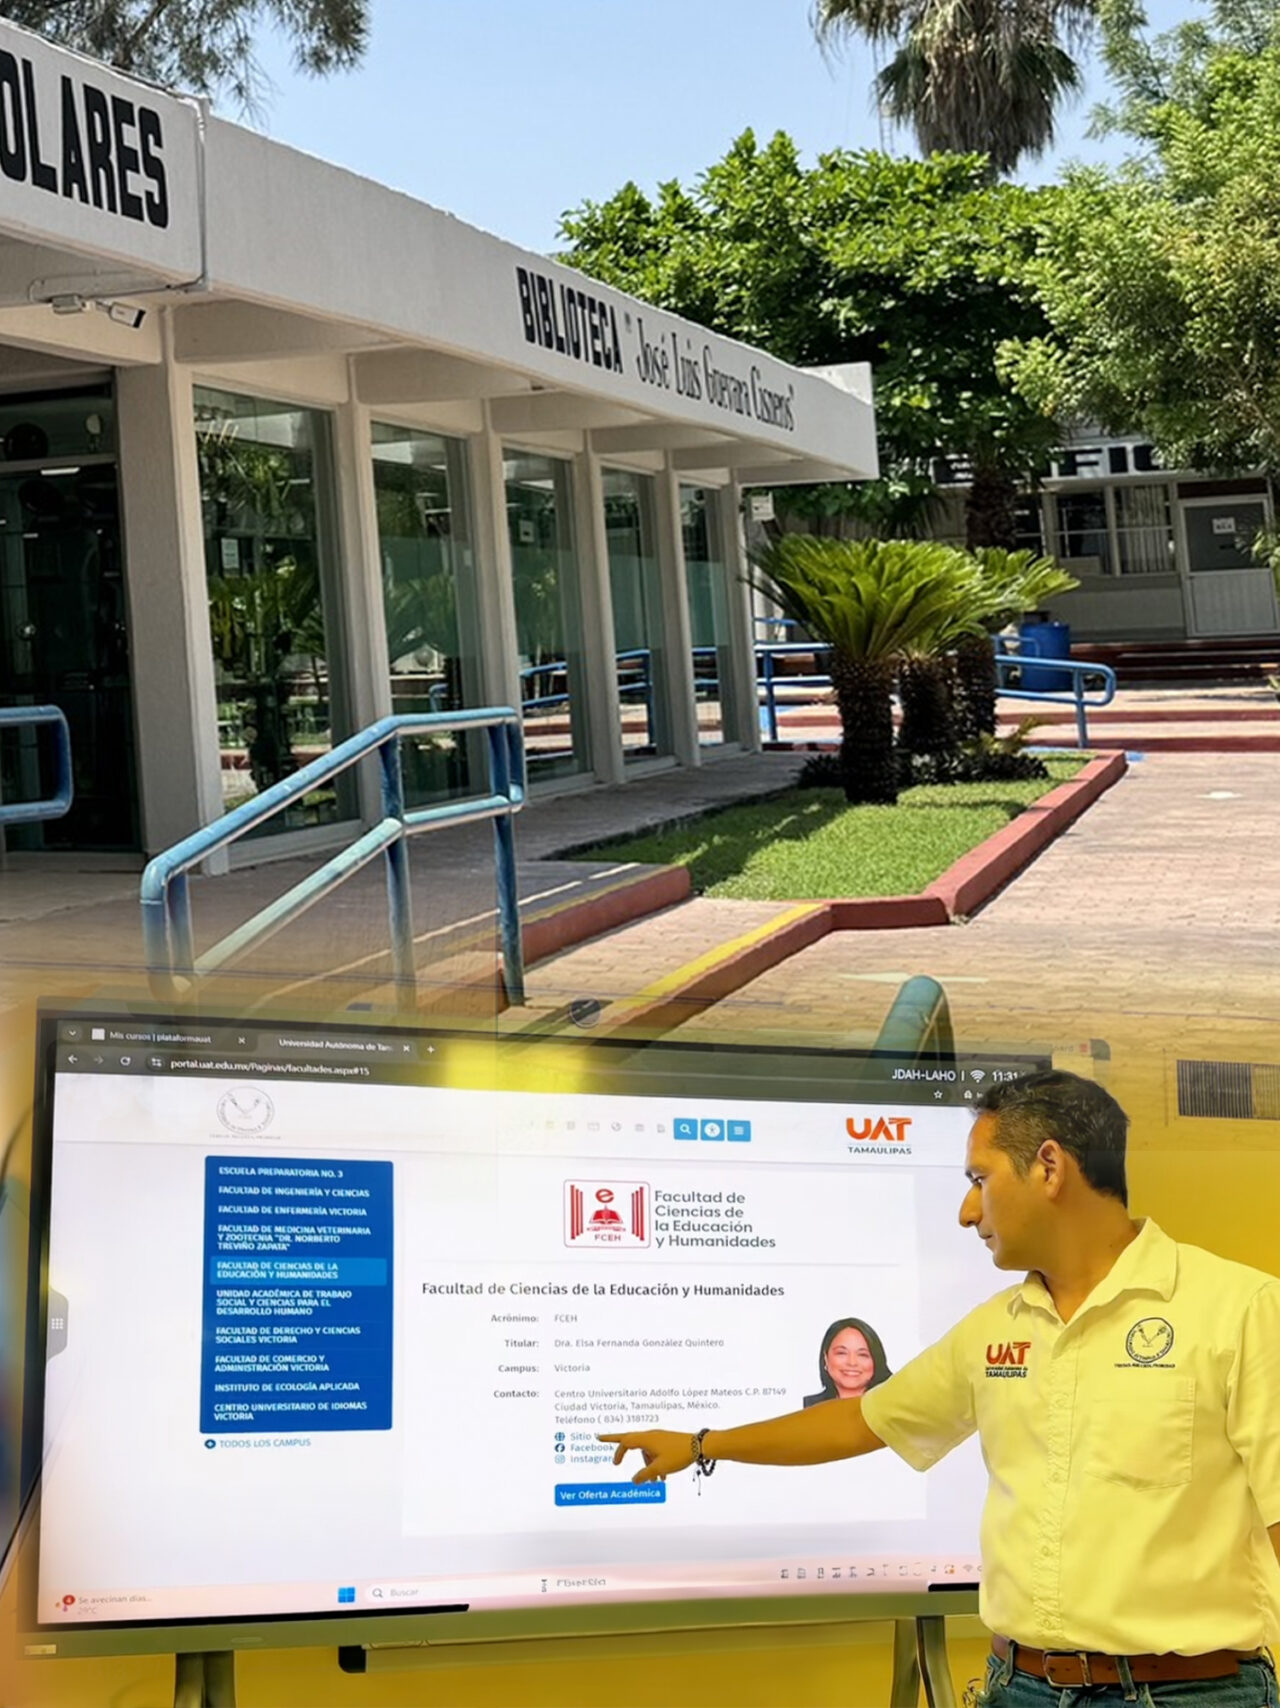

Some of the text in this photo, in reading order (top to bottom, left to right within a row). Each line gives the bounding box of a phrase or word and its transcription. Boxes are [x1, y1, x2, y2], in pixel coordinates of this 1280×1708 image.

[516, 267, 623, 374] BIBLIOTECA
[671, 332, 702, 400] Luis
[110, 1032, 124, 1040] Mis
[125, 1033, 151, 1041] cursos
[279, 1039, 323, 1048] Universidad
[325, 1041, 364, 1050] Autónoma
[366, 1043, 376, 1051] de
[892, 1069, 956, 1081] JDAH-LAHO
[846, 1116, 912, 1141] UAT
[848, 1146, 912, 1155] TAMAULIPAS
[219, 1167, 256, 1176] ESCUELA
[257, 1168, 319, 1177] PREPARATORIA
[218, 1186, 260, 1195] FACULTAD
[261, 1187, 272, 1195] DE
[275, 1187, 323, 1196] INGENIERÍA
[332, 1189, 370, 1198] CIENCIAS
[655, 1190, 745, 1204] Facultad de
[218, 1205, 367, 1216] FACULTAD DE ENFERMERÍA VICTORIA
[655, 1205, 744, 1218] Ciencias de
[218, 1225, 371, 1235] FACULTAD DE MEDICINA VETERINARIA
[655, 1220, 753, 1233] la Educación
[217, 1233, 224, 1241] Y
[225, 1233, 273, 1242] ZOOTECNIA
[295, 1235, 341, 1243] NORBERTO
[594, 1234, 621, 1242] FCEH
[655, 1235, 776, 1249] y Humanidades
[217, 1241, 255, 1250] TREVIÑO
[217, 1261, 339, 1271] FACULTAD DE CIENCIAS DE LA
[217, 1269, 339, 1279] EDUCACIÓN Y HUMANIDADES
[216, 1288, 352, 1299] UNIDAD ACADÉMICA DE TRABAJO
[422, 1282, 785, 1299] Facultad de Ciencias de la Educación y Humanidades
[216, 1299, 331, 1307] SOCIAL Y CIENCIAS PARA EL
[216, 1307, 313, 1316] DESARROLLO HUMANO
[491, 1313, 578, 1323] Acrónimo: FCEH
[215, 1327, 361, 1335] FACULTAD DE DERECHO Y CIENCIAS
[215, 1336, 298, 1344] SOCIALES VICTORIA
[504, 1338, 725, 1348] Titular: Dra. Elsa Fernanda González Quintero
[986, 1341, 1031, 1365] UAT
[215, 1355, 325, 1364] FACULTAD DE COMERCIO Y
[215, 1362, 330, 1372] ADMINISTRACIÓN VICTORIA
[498, 1363, 591, 1374] Campus: Victoria
[215, 1382, 360, 1392] INSTITUTO DE ECOLOGÍA APLICADA
[493, 1389, 539, 1398] Contacto:
[554, 1390, 586, 1399] Centro
[588, 1388, 648, 1398] Universitario
[650, 1388, 680, 1397] Adolfo
[682, 1387, 708, 1399] López
[711, 1388, 743, 1397] Mateos
[745, 1388, 760, 1396] C.P.
[214, 1402, 367, 1413] CENTRO UNIVERSITARIO DE IDIOMAS
[554, 1400, 720, 1411] Ciudad Victoria, Tamaulipas, México.
[214, 1412, 254, 1421] VICTORIA
[555, 1415, 596, 1424] Teléfono
[570, 1432, 592, 1441] Sitio
[220, 1439, 311, 1448] TODOS LOS CAMPUS
[570, 1444, 614, 1452] Facebook
[560, 1488, 661, 1500] Ver Oferta Académica
[390, 1588, 419, 1597] Buscar
